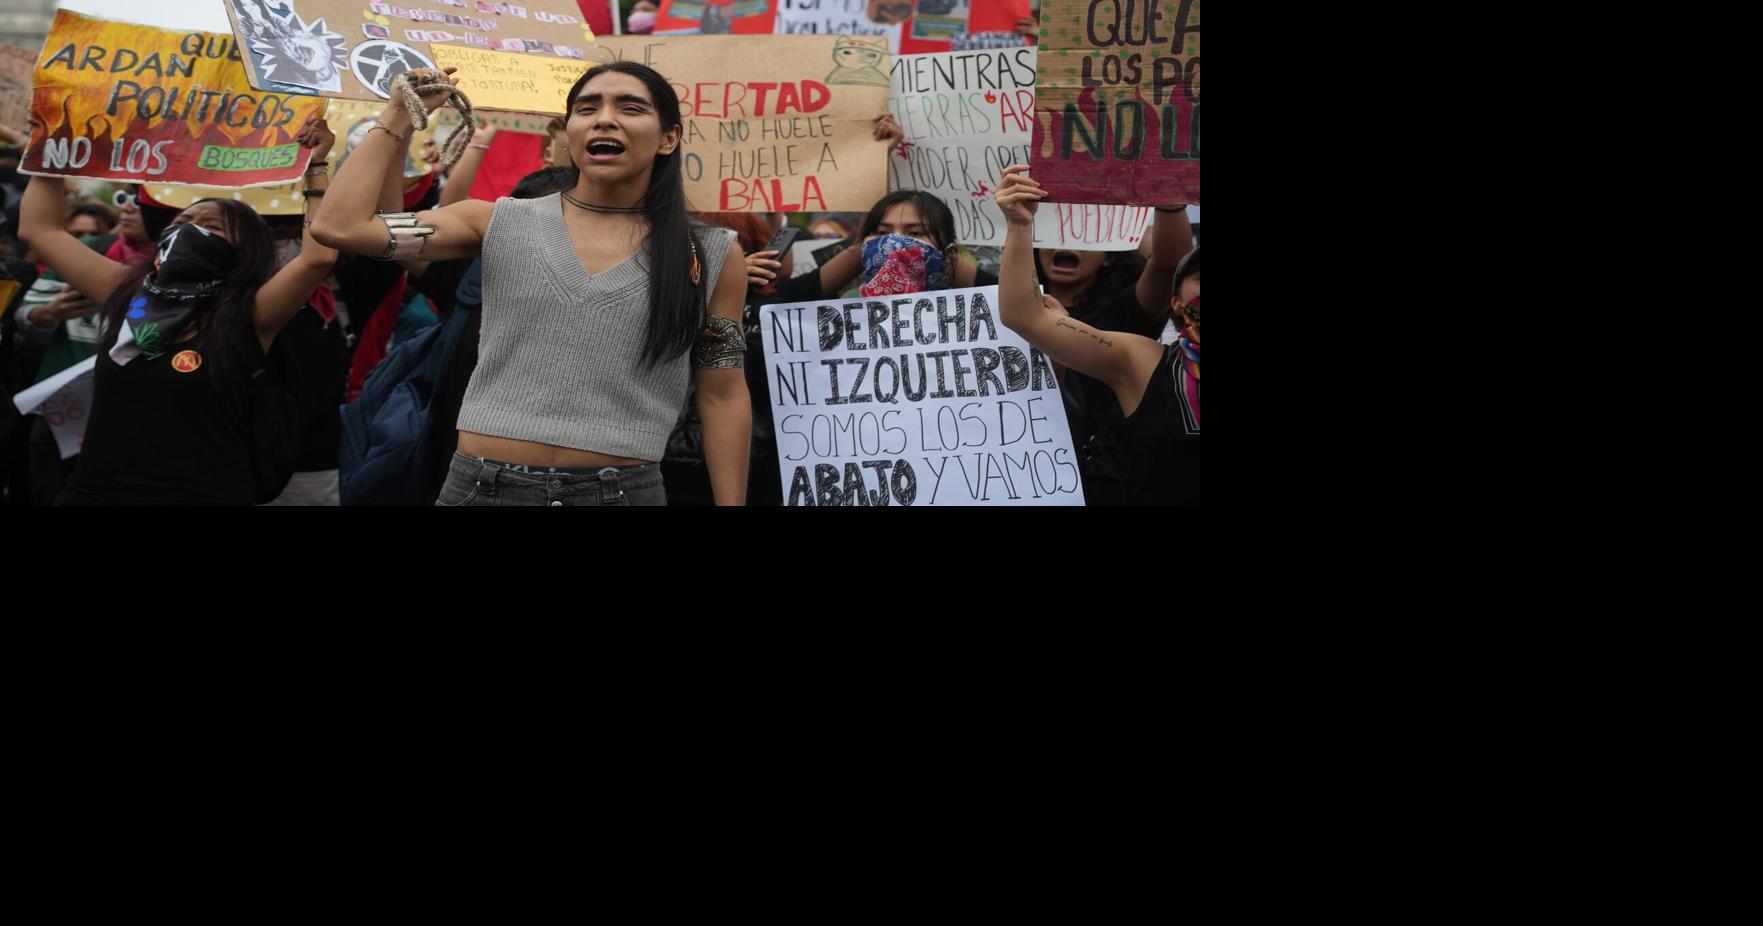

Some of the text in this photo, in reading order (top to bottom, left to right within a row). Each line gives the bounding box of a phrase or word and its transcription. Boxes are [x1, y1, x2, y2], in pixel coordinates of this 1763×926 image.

[43, 43, 196, 78] ARDAN
[1082, 53, 1142, 86] LOS
[670, 79, 831, 118] BERTAD
[719, 120, 750, 142] NO
[762, 114, 833, 140] HUELE
[1061, 101, 1145, 160] NO
[42, 138, 295, 175] NO LOS BOSQUES
[718, 144, 798, 181] HUELE
[817, 142, 838, 172] A
[719, 175, 828, 212] BALA
[771, 308, 810, 354] NI
[817, 293, 998, 351] DERECHA
[776, 345, 1057, 406] NI IZQUIERDA
[781, 396, 1053, 461] SOMOS LOS DE
[787, 448, 1080, 506] ABAJO Y VAMOS
